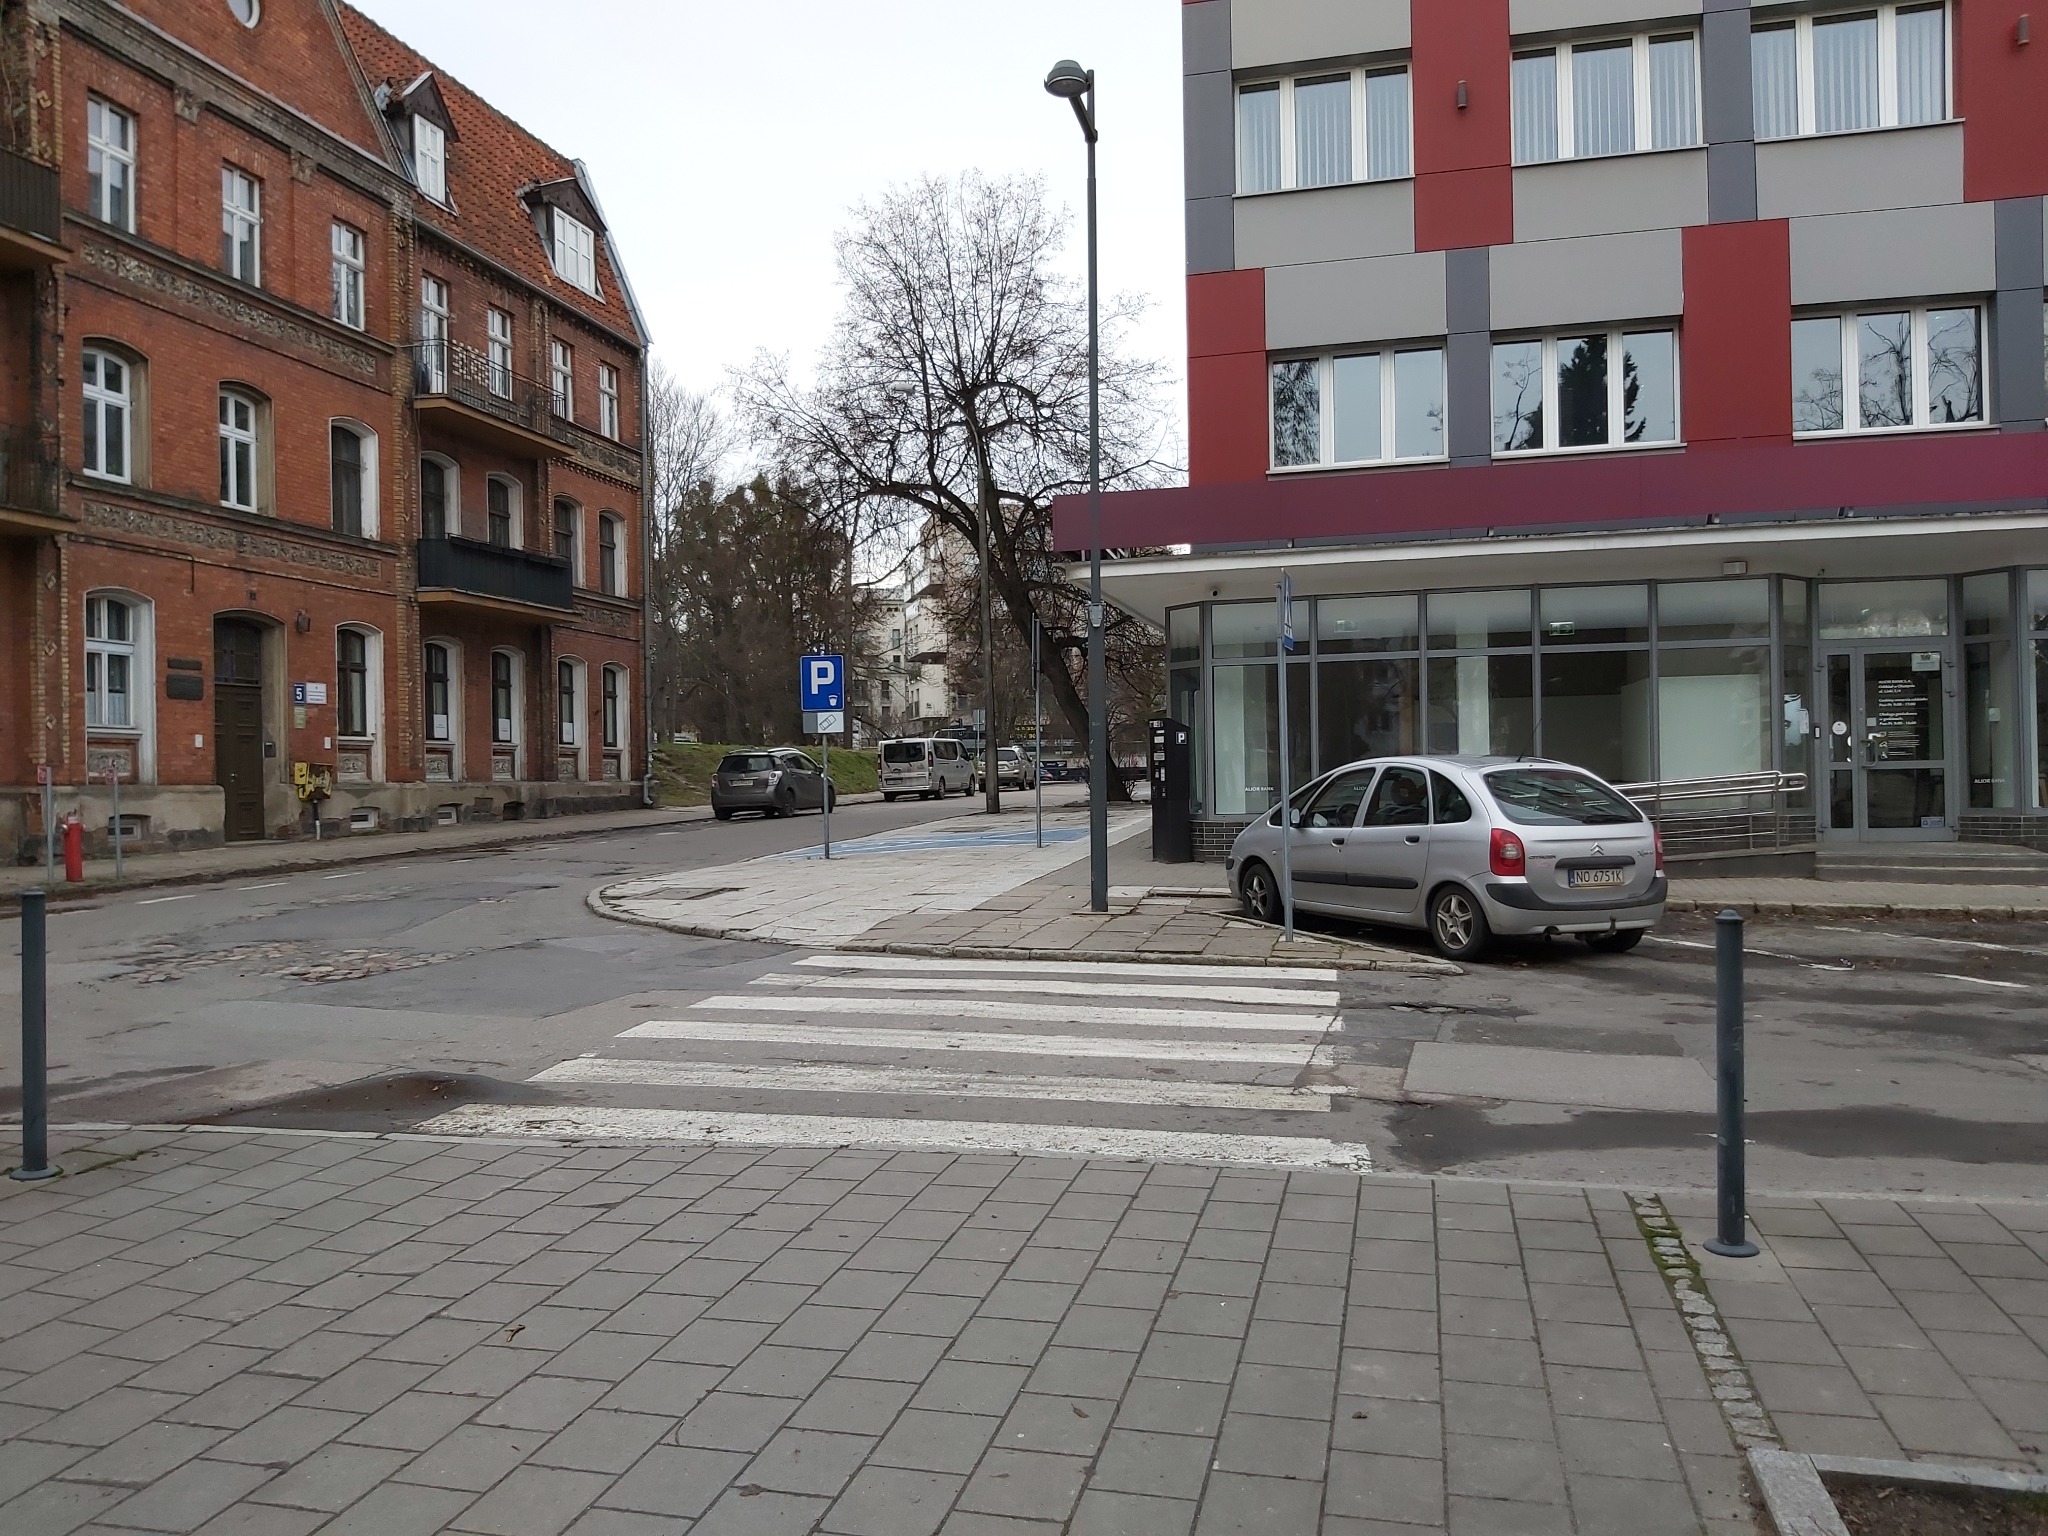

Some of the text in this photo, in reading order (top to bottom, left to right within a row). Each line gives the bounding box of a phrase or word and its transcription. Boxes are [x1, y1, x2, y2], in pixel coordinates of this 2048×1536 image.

[810, 660, 835, 695] P
[296, 688, 303, 700] 5
[1178, 733, 1185, 743] P
[1576, 870, 1622, 882] NO 6751K
